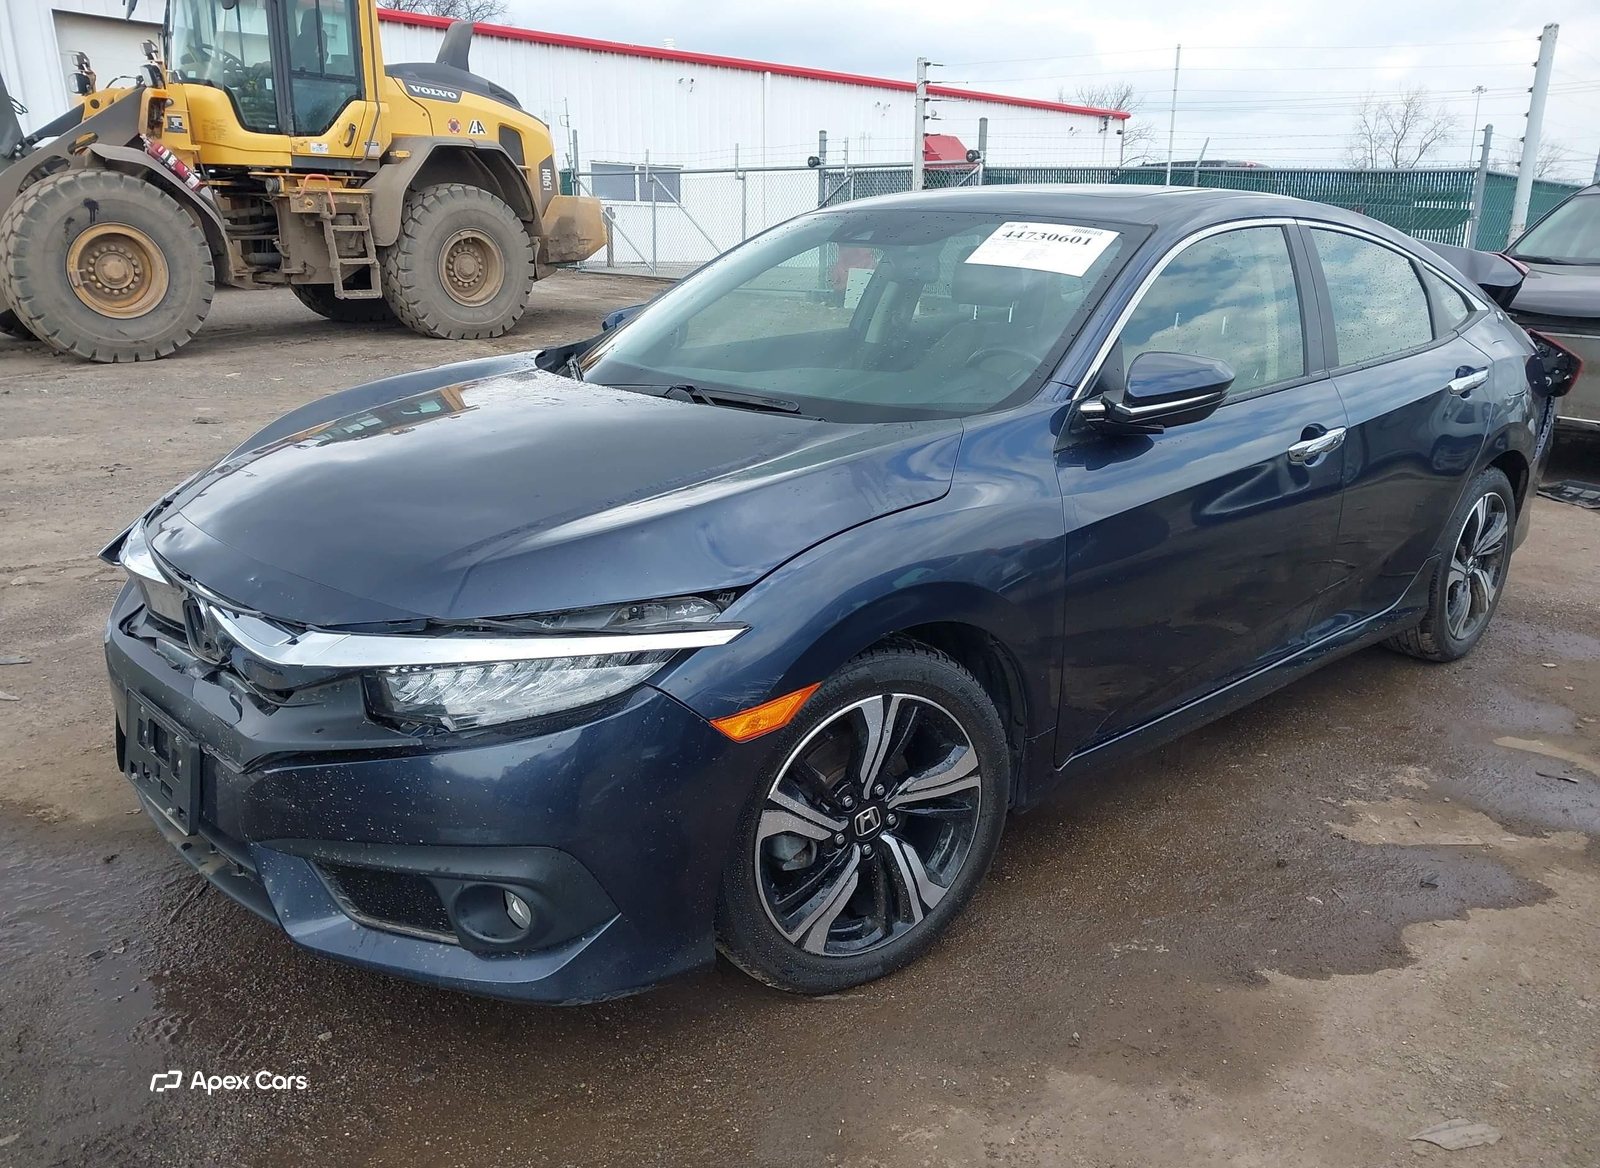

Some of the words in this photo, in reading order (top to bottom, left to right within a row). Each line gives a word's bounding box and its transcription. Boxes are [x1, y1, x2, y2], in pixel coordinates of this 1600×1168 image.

[408, 84, 458, 99] VOLVO
[542, 169, 552, 190] L90H
[1002, 230, 1093, 246] 44730601
